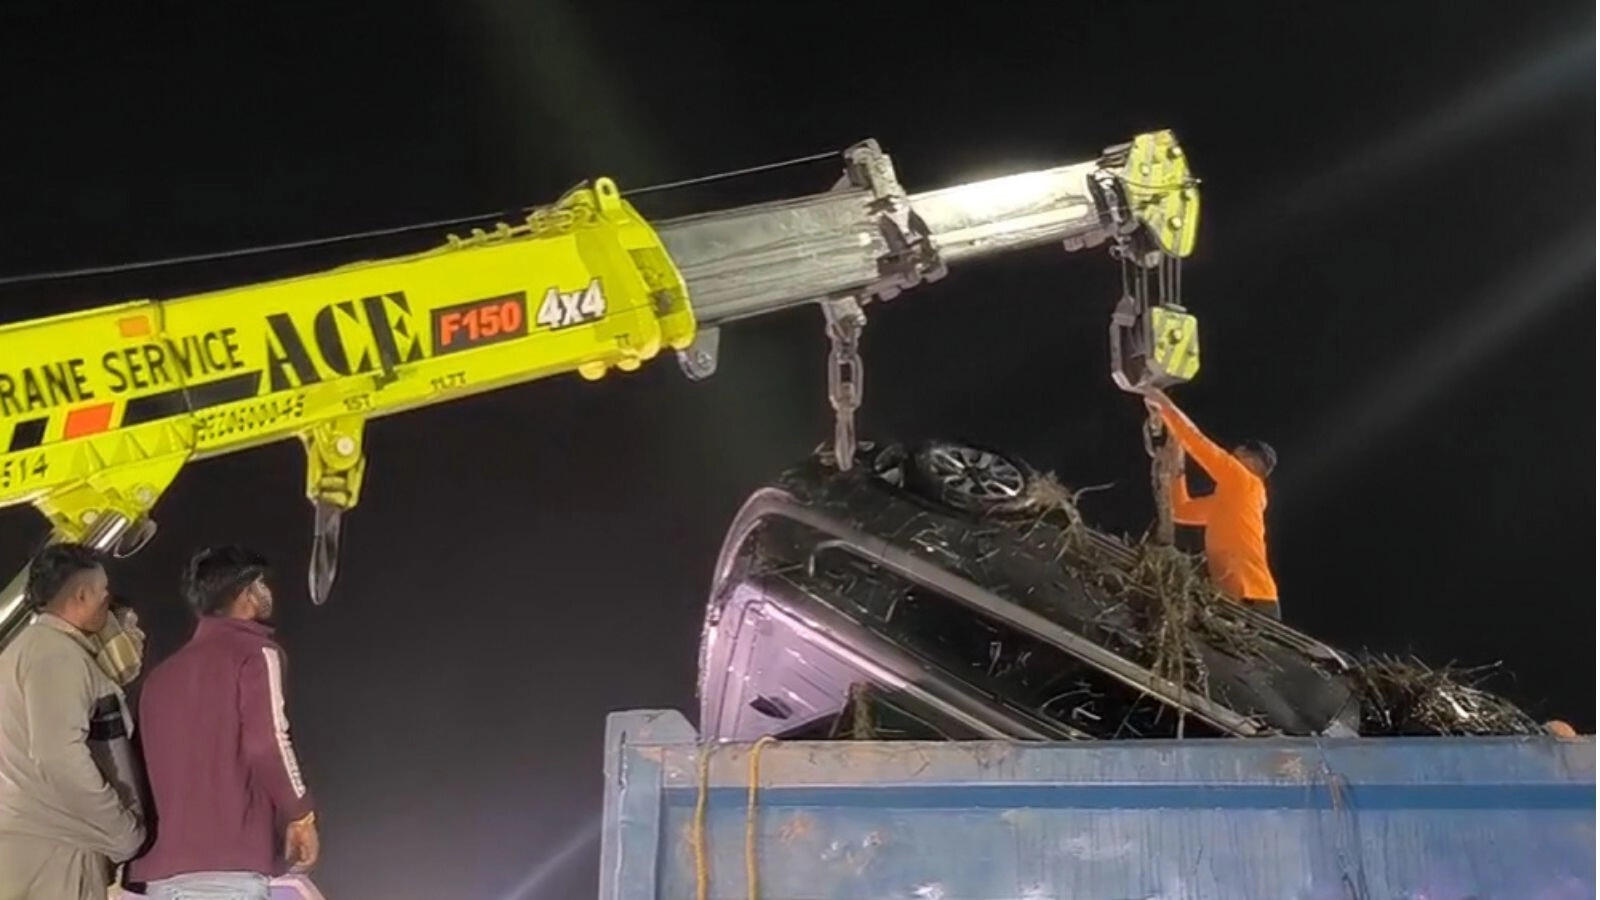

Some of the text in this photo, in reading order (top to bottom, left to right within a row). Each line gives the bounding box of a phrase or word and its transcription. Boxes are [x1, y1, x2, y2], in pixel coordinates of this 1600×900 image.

[440, 299, 522, 346] F150
[536, 276, 608, 331] 4x4
[0, 327, 245, 416] RANE SERVICE
[264, 290, 425, 392] ACE
